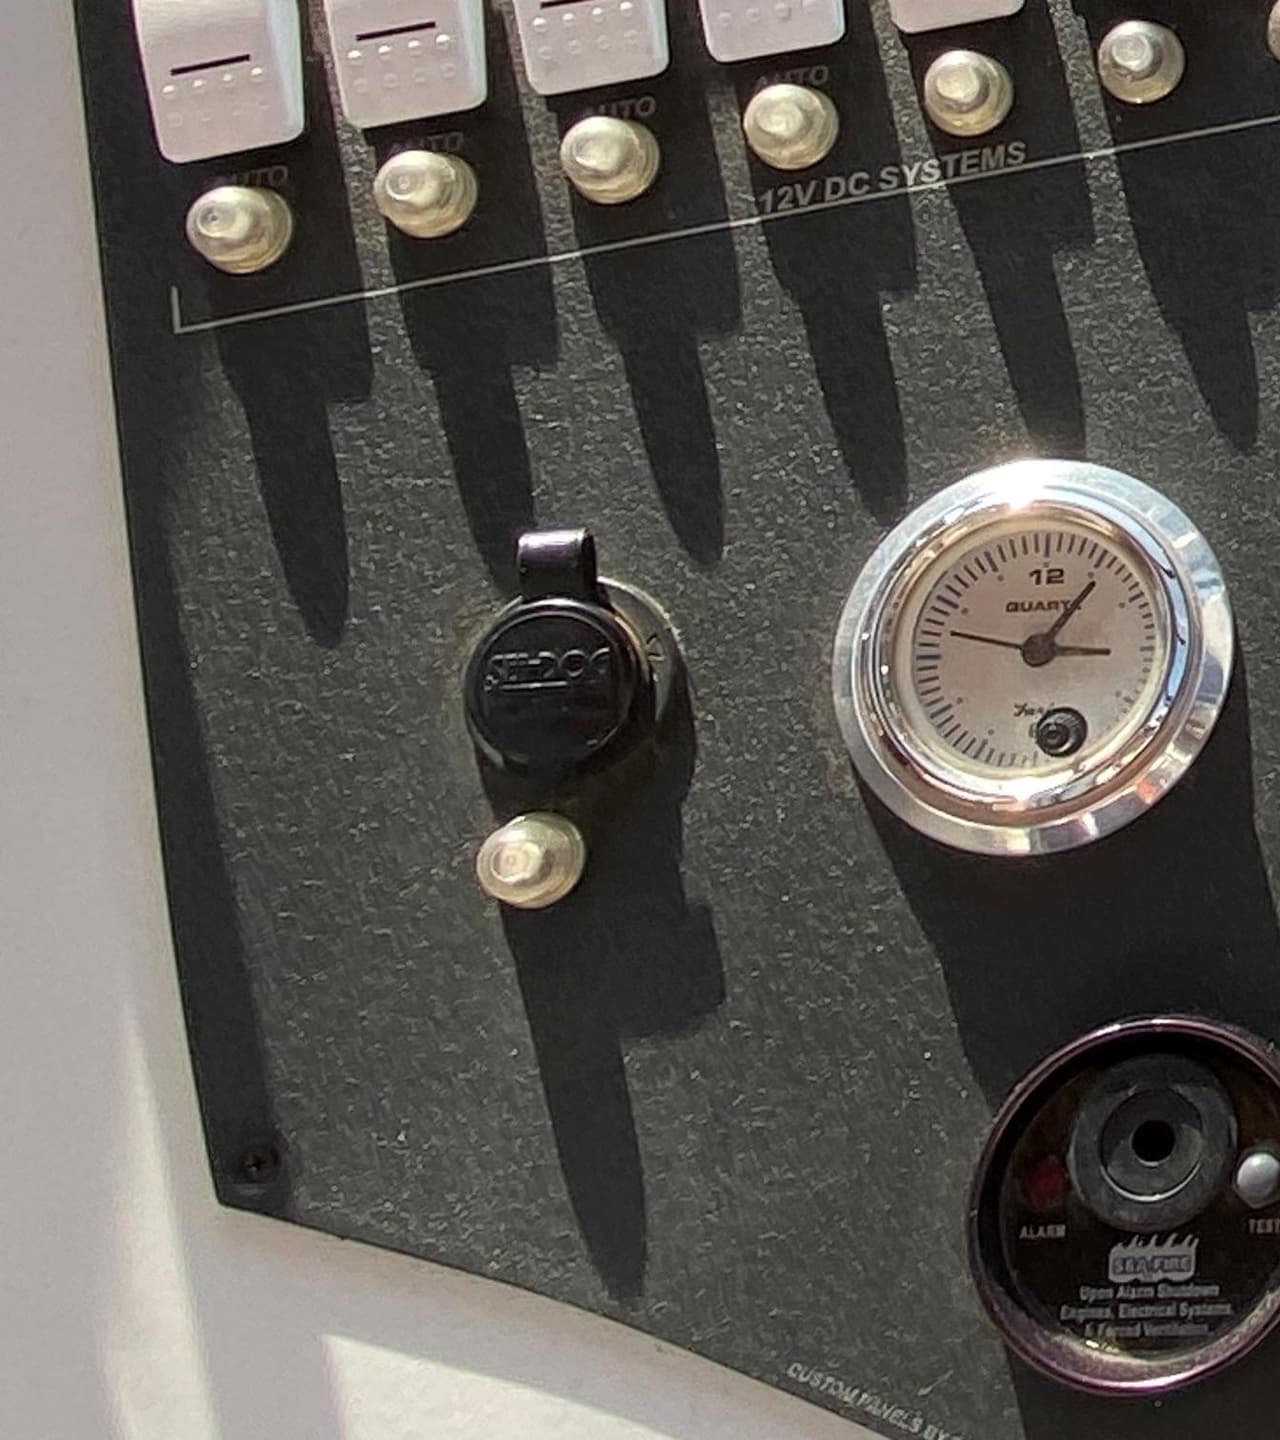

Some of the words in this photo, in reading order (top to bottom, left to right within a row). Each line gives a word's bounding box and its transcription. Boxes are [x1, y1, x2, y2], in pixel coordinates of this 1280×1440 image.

[758, 180, 817, 213] 12V
[824, 171, 870, 200] DC
[878, 141, 1026, 191] SYSTEMS
[1029, 568, 1065, 585] 12
[1019, 1224, 1066, 1240] ALARM
[786, 1361, 859, 1403] CUSTOM
[855, 1391, 924, 1433] PANELS
